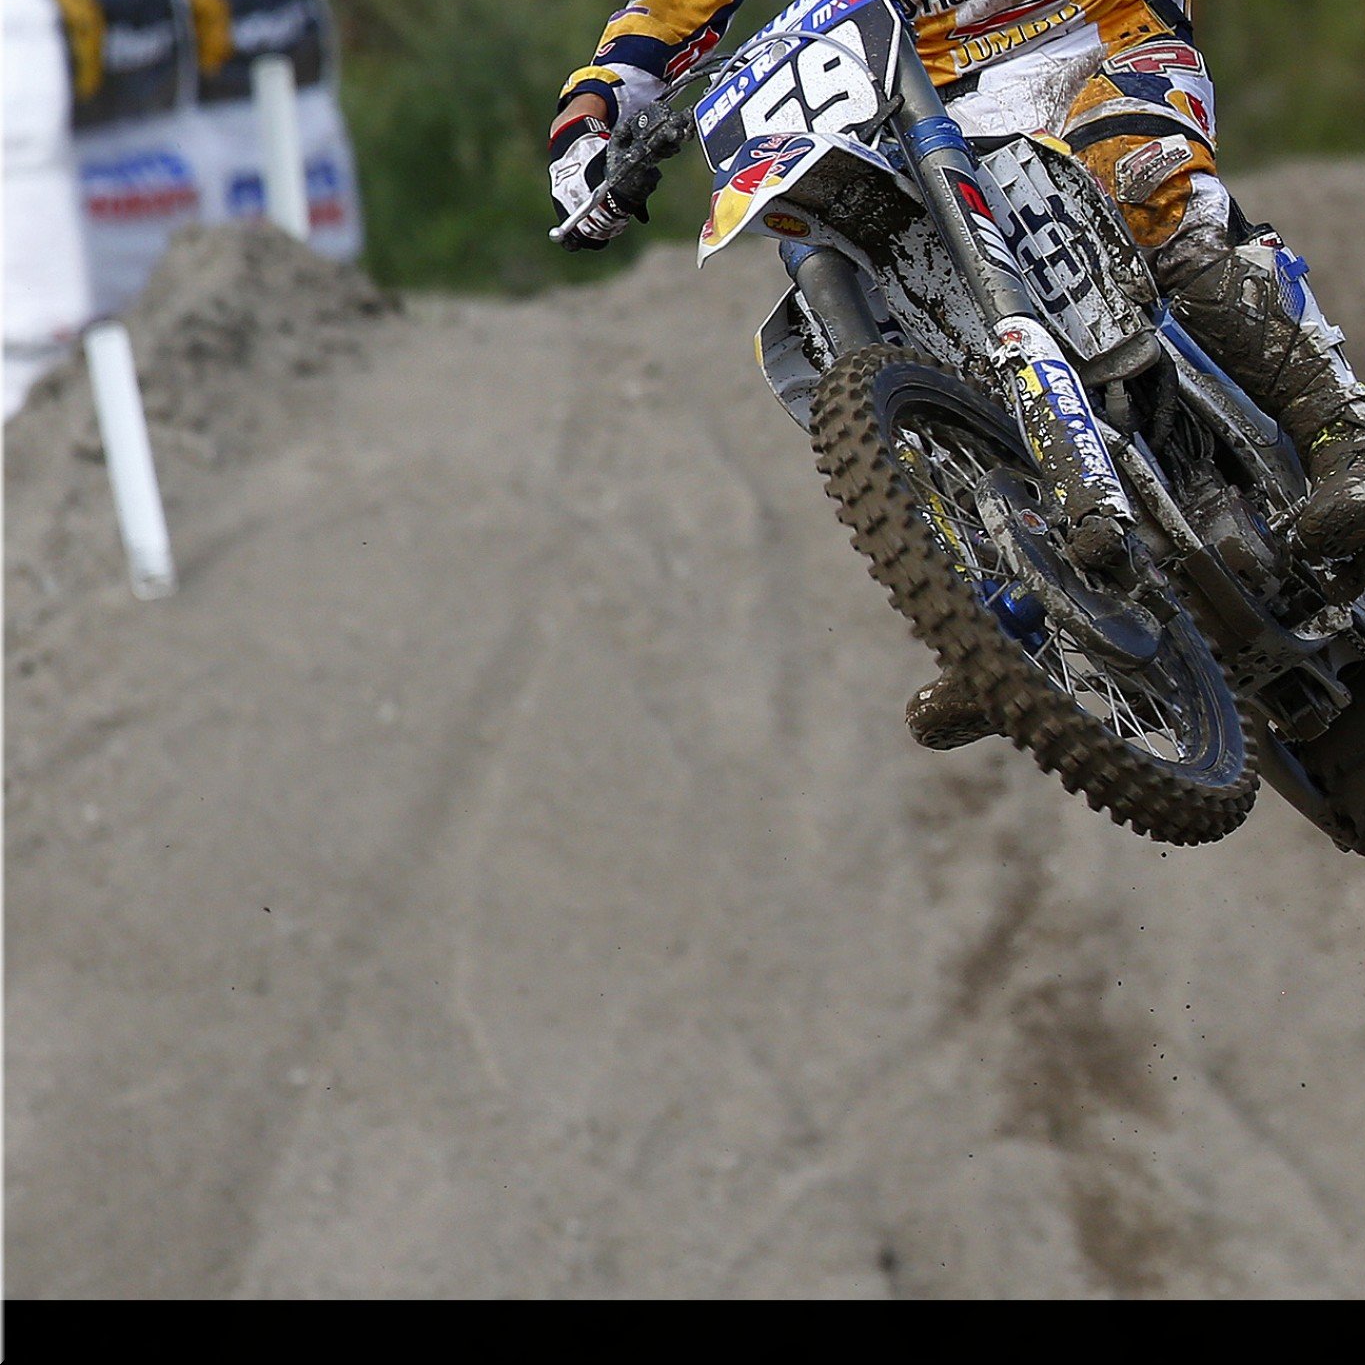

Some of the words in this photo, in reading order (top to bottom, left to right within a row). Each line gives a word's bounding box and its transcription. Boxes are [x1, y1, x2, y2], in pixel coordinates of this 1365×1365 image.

[955, 4, 1081, 69] JUMBO
[728, 19, 879, 160] 59
[766, 216, 808, 235] FMF
